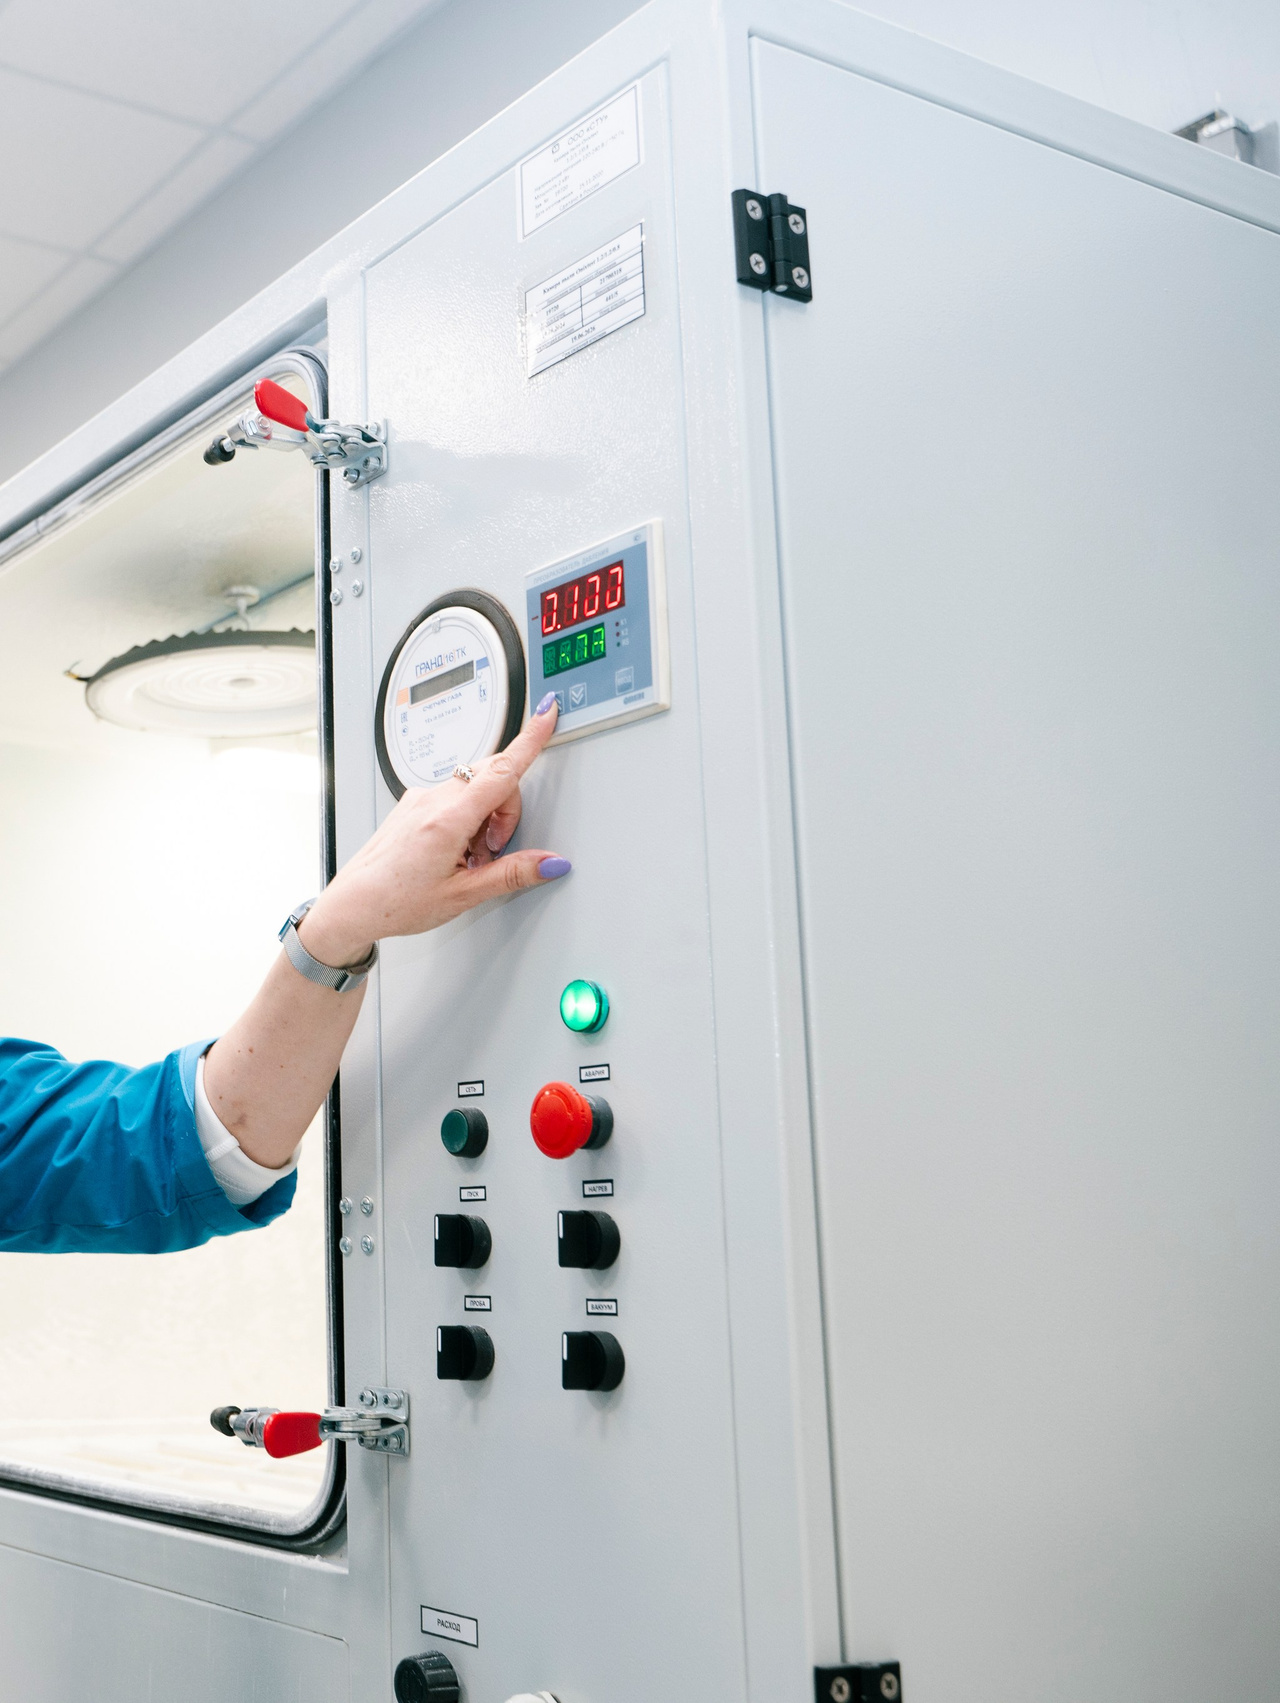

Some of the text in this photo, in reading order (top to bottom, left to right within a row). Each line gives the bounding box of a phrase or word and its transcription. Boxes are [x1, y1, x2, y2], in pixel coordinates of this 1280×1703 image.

[415, 654, 444, 677] ГРАНД
[584, 1069, 605, 1078] АВАРИЯ
[588, 1185, 608, 1193] НАГРЕВ
[467, 1190, 479, 1198] ПУСК
[590, 1303, 613, 1311] ВАКУУМ
[436, 1618, 461, 1633] РАСХОД
